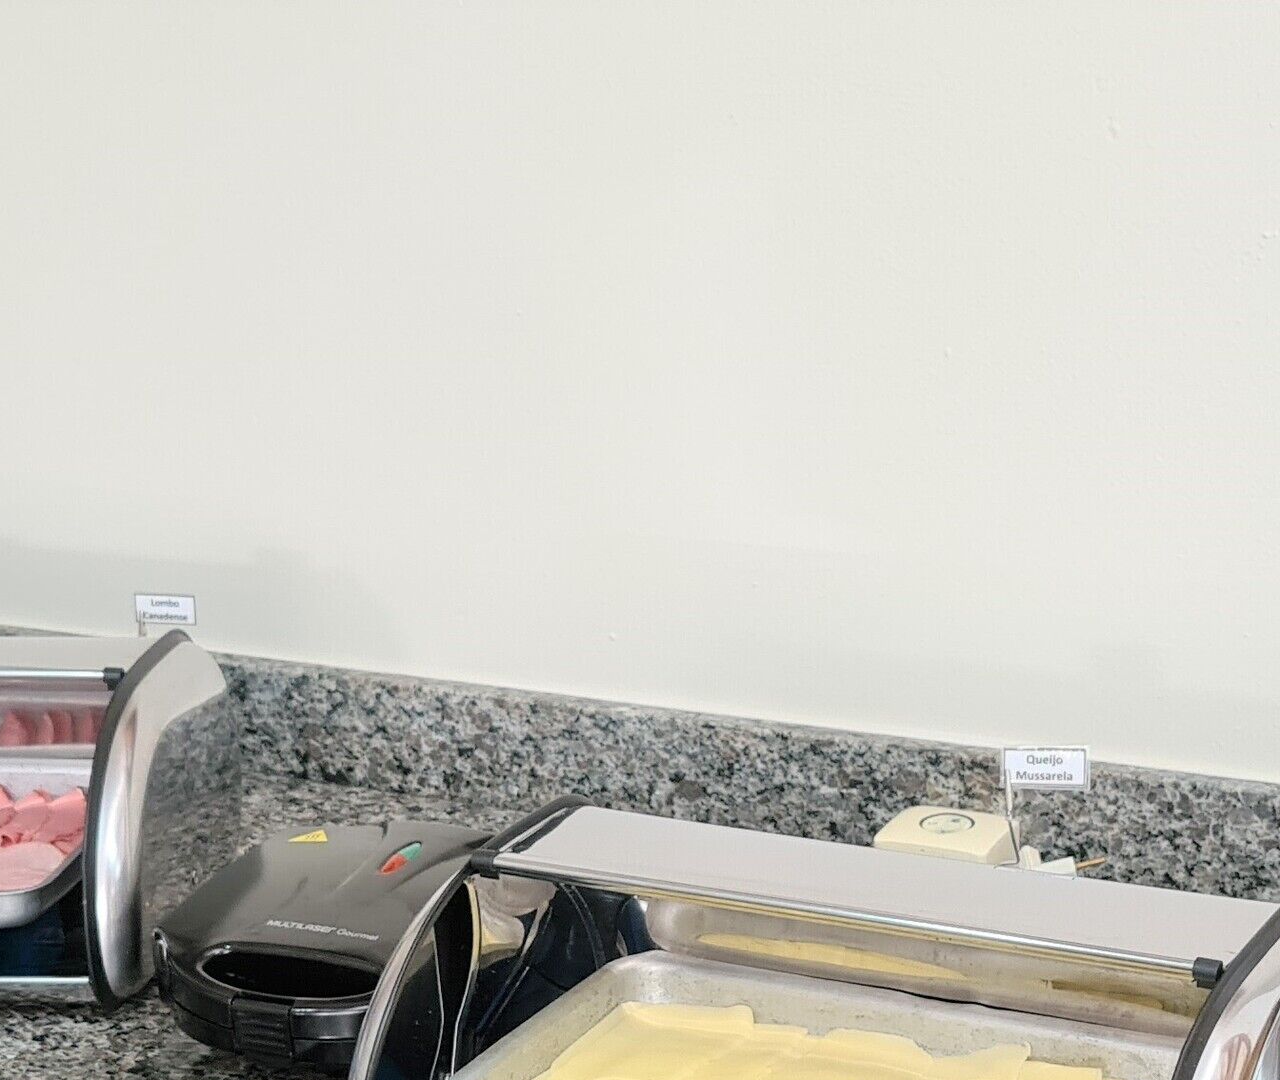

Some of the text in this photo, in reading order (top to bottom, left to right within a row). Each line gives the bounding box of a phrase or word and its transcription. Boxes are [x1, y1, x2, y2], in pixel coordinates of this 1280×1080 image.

[151, 598, 180, 608] Lombo
[1026, 755, 1064, 766] Queijo
[1015, 771, 1073, 780] Mussarela
[336, 928, 380, 941] Gourmet
